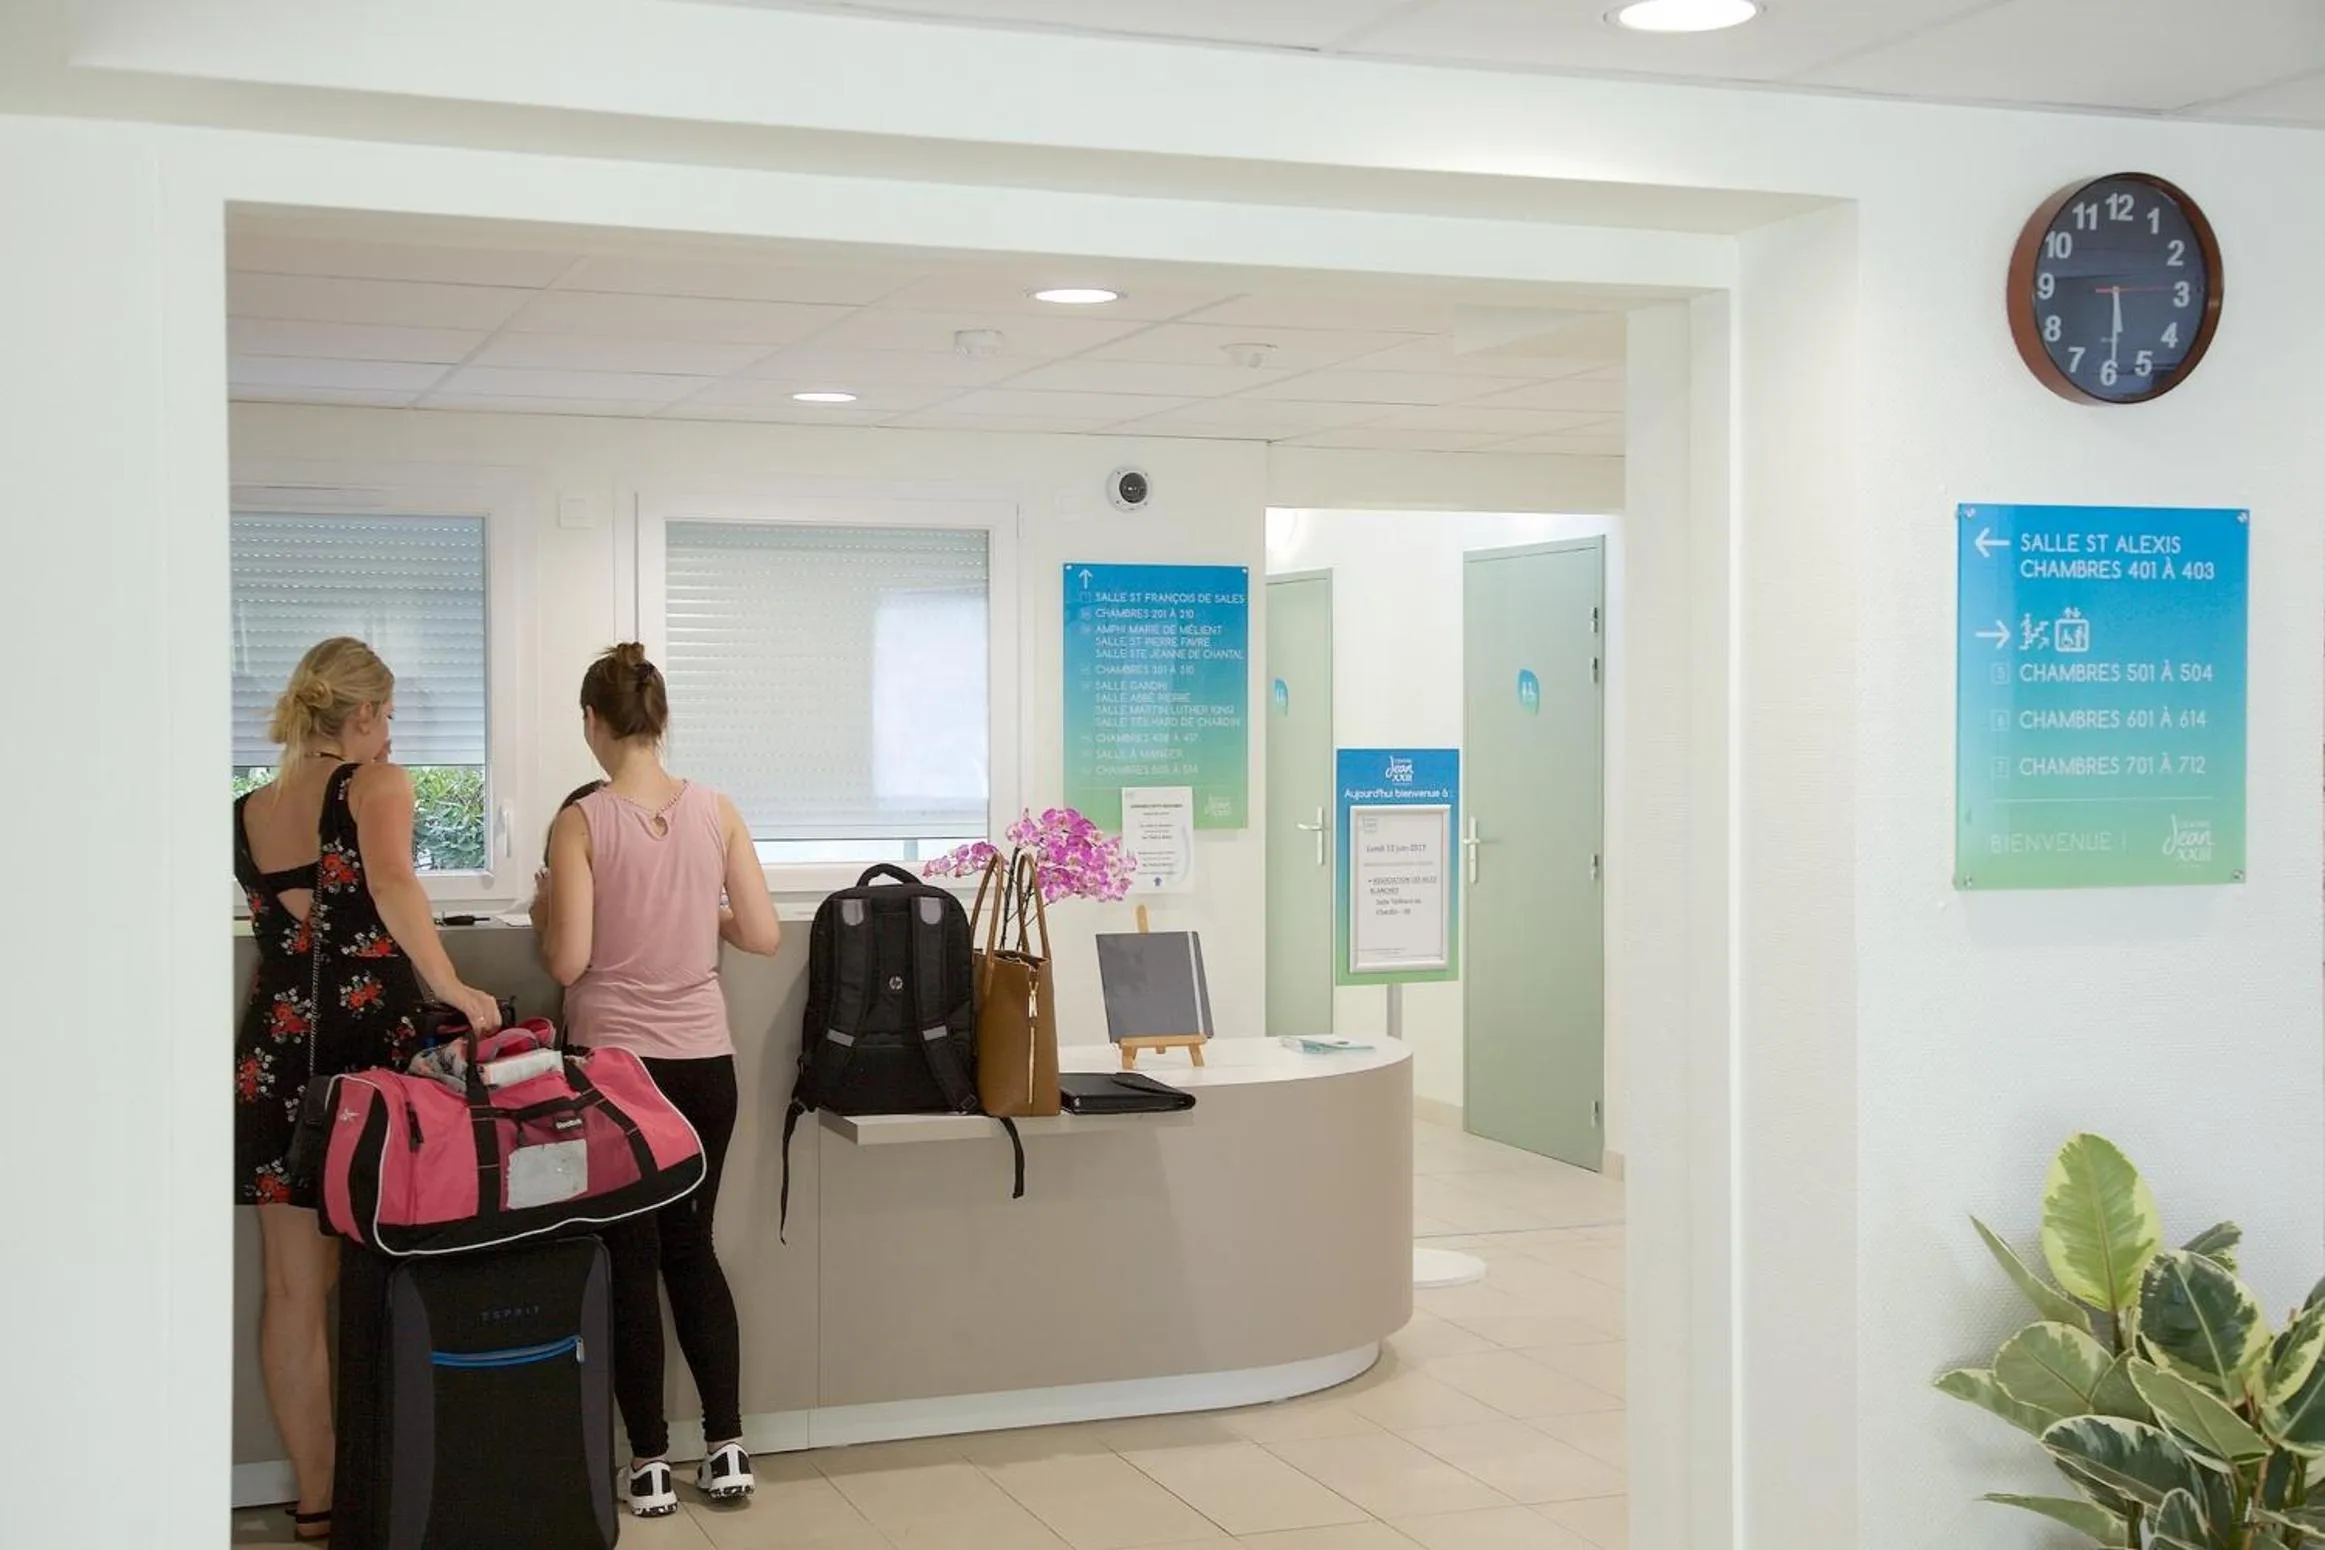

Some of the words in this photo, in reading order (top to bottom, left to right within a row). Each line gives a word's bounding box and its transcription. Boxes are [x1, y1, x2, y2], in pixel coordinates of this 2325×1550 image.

[2072, 202, 2099, 230] 11
[2105, 192, 2135, 221] 12
[2147, 208, 2160, 235] 1
[2045, 231, 2073, 259] 10
[2166, 239, 2186, 266] 2
[2037, 273, 2055, 300] 9
[2173, 281, 2190, 308] 3
[2044, 315, 2062, 342] 8
[2160, 322, 2178, 349] 4
[2068, 347, 2086, 373] 7
[2100, 359, 2118, 386] 6
[2134, 350, 2153, 377] 5
[2020, 534, 2080, 553] SALLE
[2086, 534, 2109, 553] ST
[2115, 536, 2181, 554] ALEXIS
[2020, 560, 2121, 579] CHAMBRES
[2128, 561, 2156, 579] 401
[2162, 556, 2176, 580] À
[2182, 562, 2215, 580] 403
[1095, 592, 1127, 602] SALLE
[2020, 664, 2121, 682] CHAMBRES
[2127, 664, 2155, 682] 501
[2160, 659, 2175, 682] À
[2180, 664, 2213, 682] 504
[2019, 710, 2120, 730] CHAMBRES
[2126, 711, 2154, 729] 601
[2160, 706, 2173, 729] À
[2179, 710, 2207, 729] 614
[2019, 757, 2119, 776] CHAMBRES
[2126, 757, 2154, 775] 701
[2159, 752, 2173, 775] À
[2179, 756, 2206, 775] 712
[1344, 789, 1393, 801] Aujourd'hui
[1395, 788, 1440, 798] bienvenue
[1441, 788, 1449, 798] à
[1990, 832, 2112, 854] BIENVENUE
